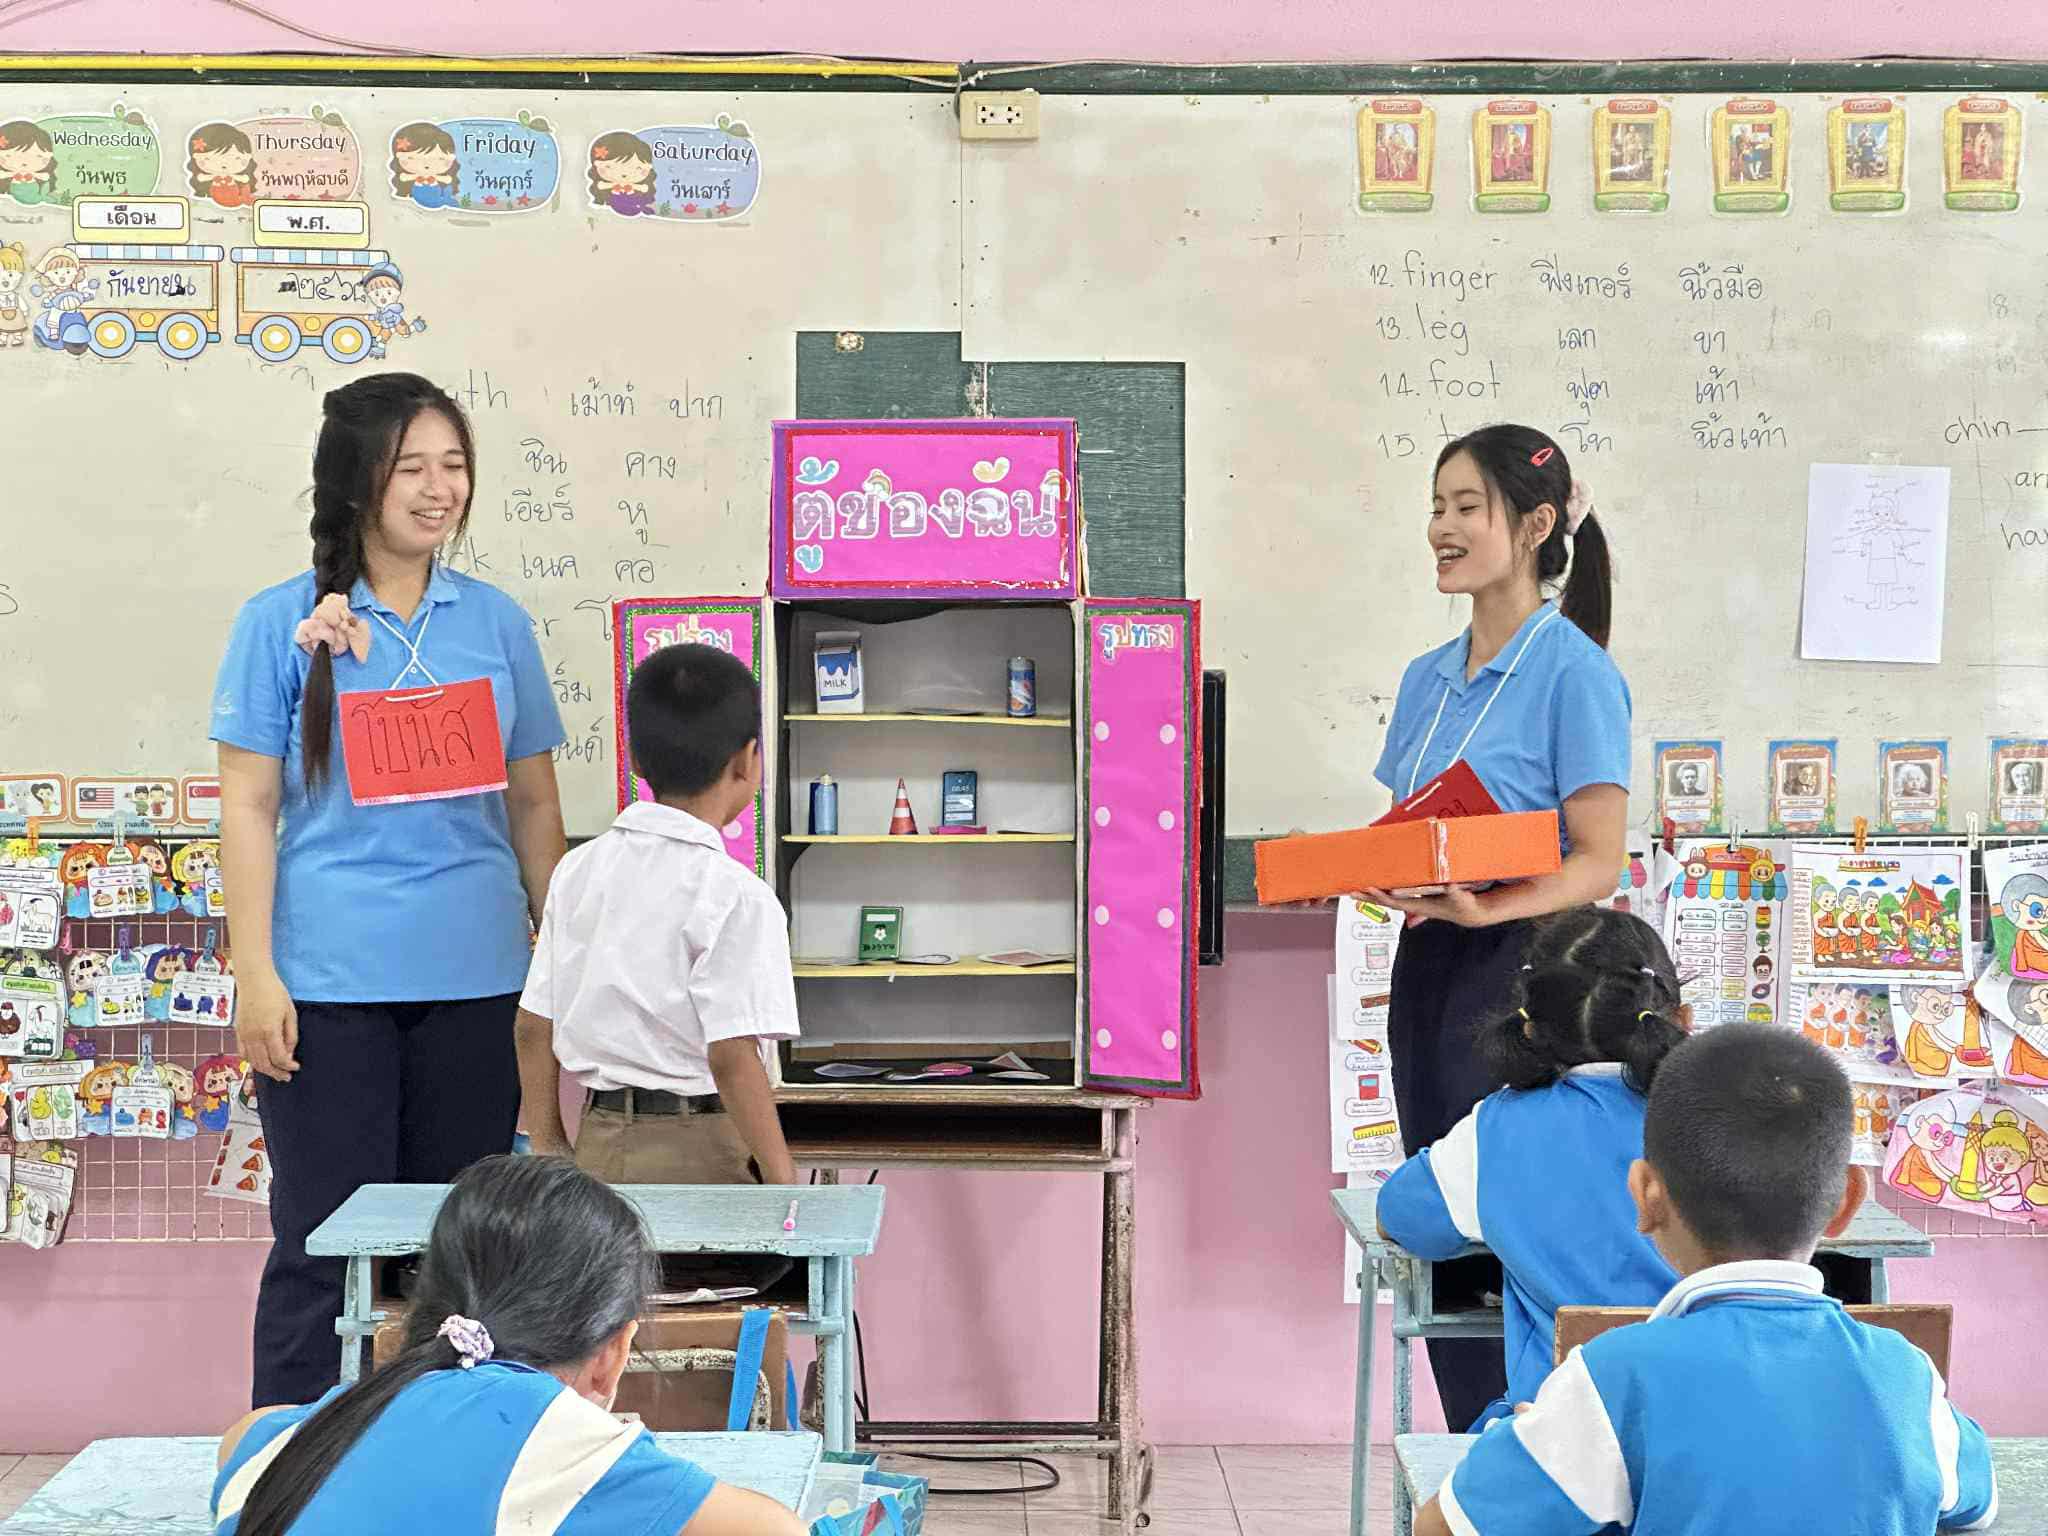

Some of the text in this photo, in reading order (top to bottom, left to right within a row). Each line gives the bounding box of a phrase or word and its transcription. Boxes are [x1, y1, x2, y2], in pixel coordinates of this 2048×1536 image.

[53, 131, 153, 150] Wednesday
[255, 132, 347, 153] Thursday
[463, 132, 536, 160] Friday
[653, 140, 754, 164] Saturday
[75, 165, 127, 192] วันพุธ
[261, 168, 349, 191] วันพฤหัสบดี
[474, 168, 534, 198] วันศุกร์
[670, 178, 731, 200] วันเสาร์
[107, 203, 157, 227] เดือน
[287, 212, 330, 231] พ.ศ.
[1402, 250, 1498, 301] finger
[1530, 254, 1632, 300] ฟิงเกอร์
[1679, 261, 1762, 300] นิ้วมือ
[1416, 303, 1468, 356] leg
[1693, 328, 1726, 353] ขา
[1427, 358, 1501, 399] foot
[1695, 365, 1740, 402] เท้า
[669, 377, 723, 419] ปาก
[1944, 416, 2011, 445] chin
[519, 438, 568, 475] ชิน
[625, 451, 677, 479] คาง
[2014, 470, 2048, 489] ar
[618, 499, 648, 546] หู
[793, 454, 1060, 574] ตู้ของฉัน
[614, 558, 656, 584] คอ
[1099, 618, 1175, 661] รูปทรง
[823, 679, 848, 689] MILK
